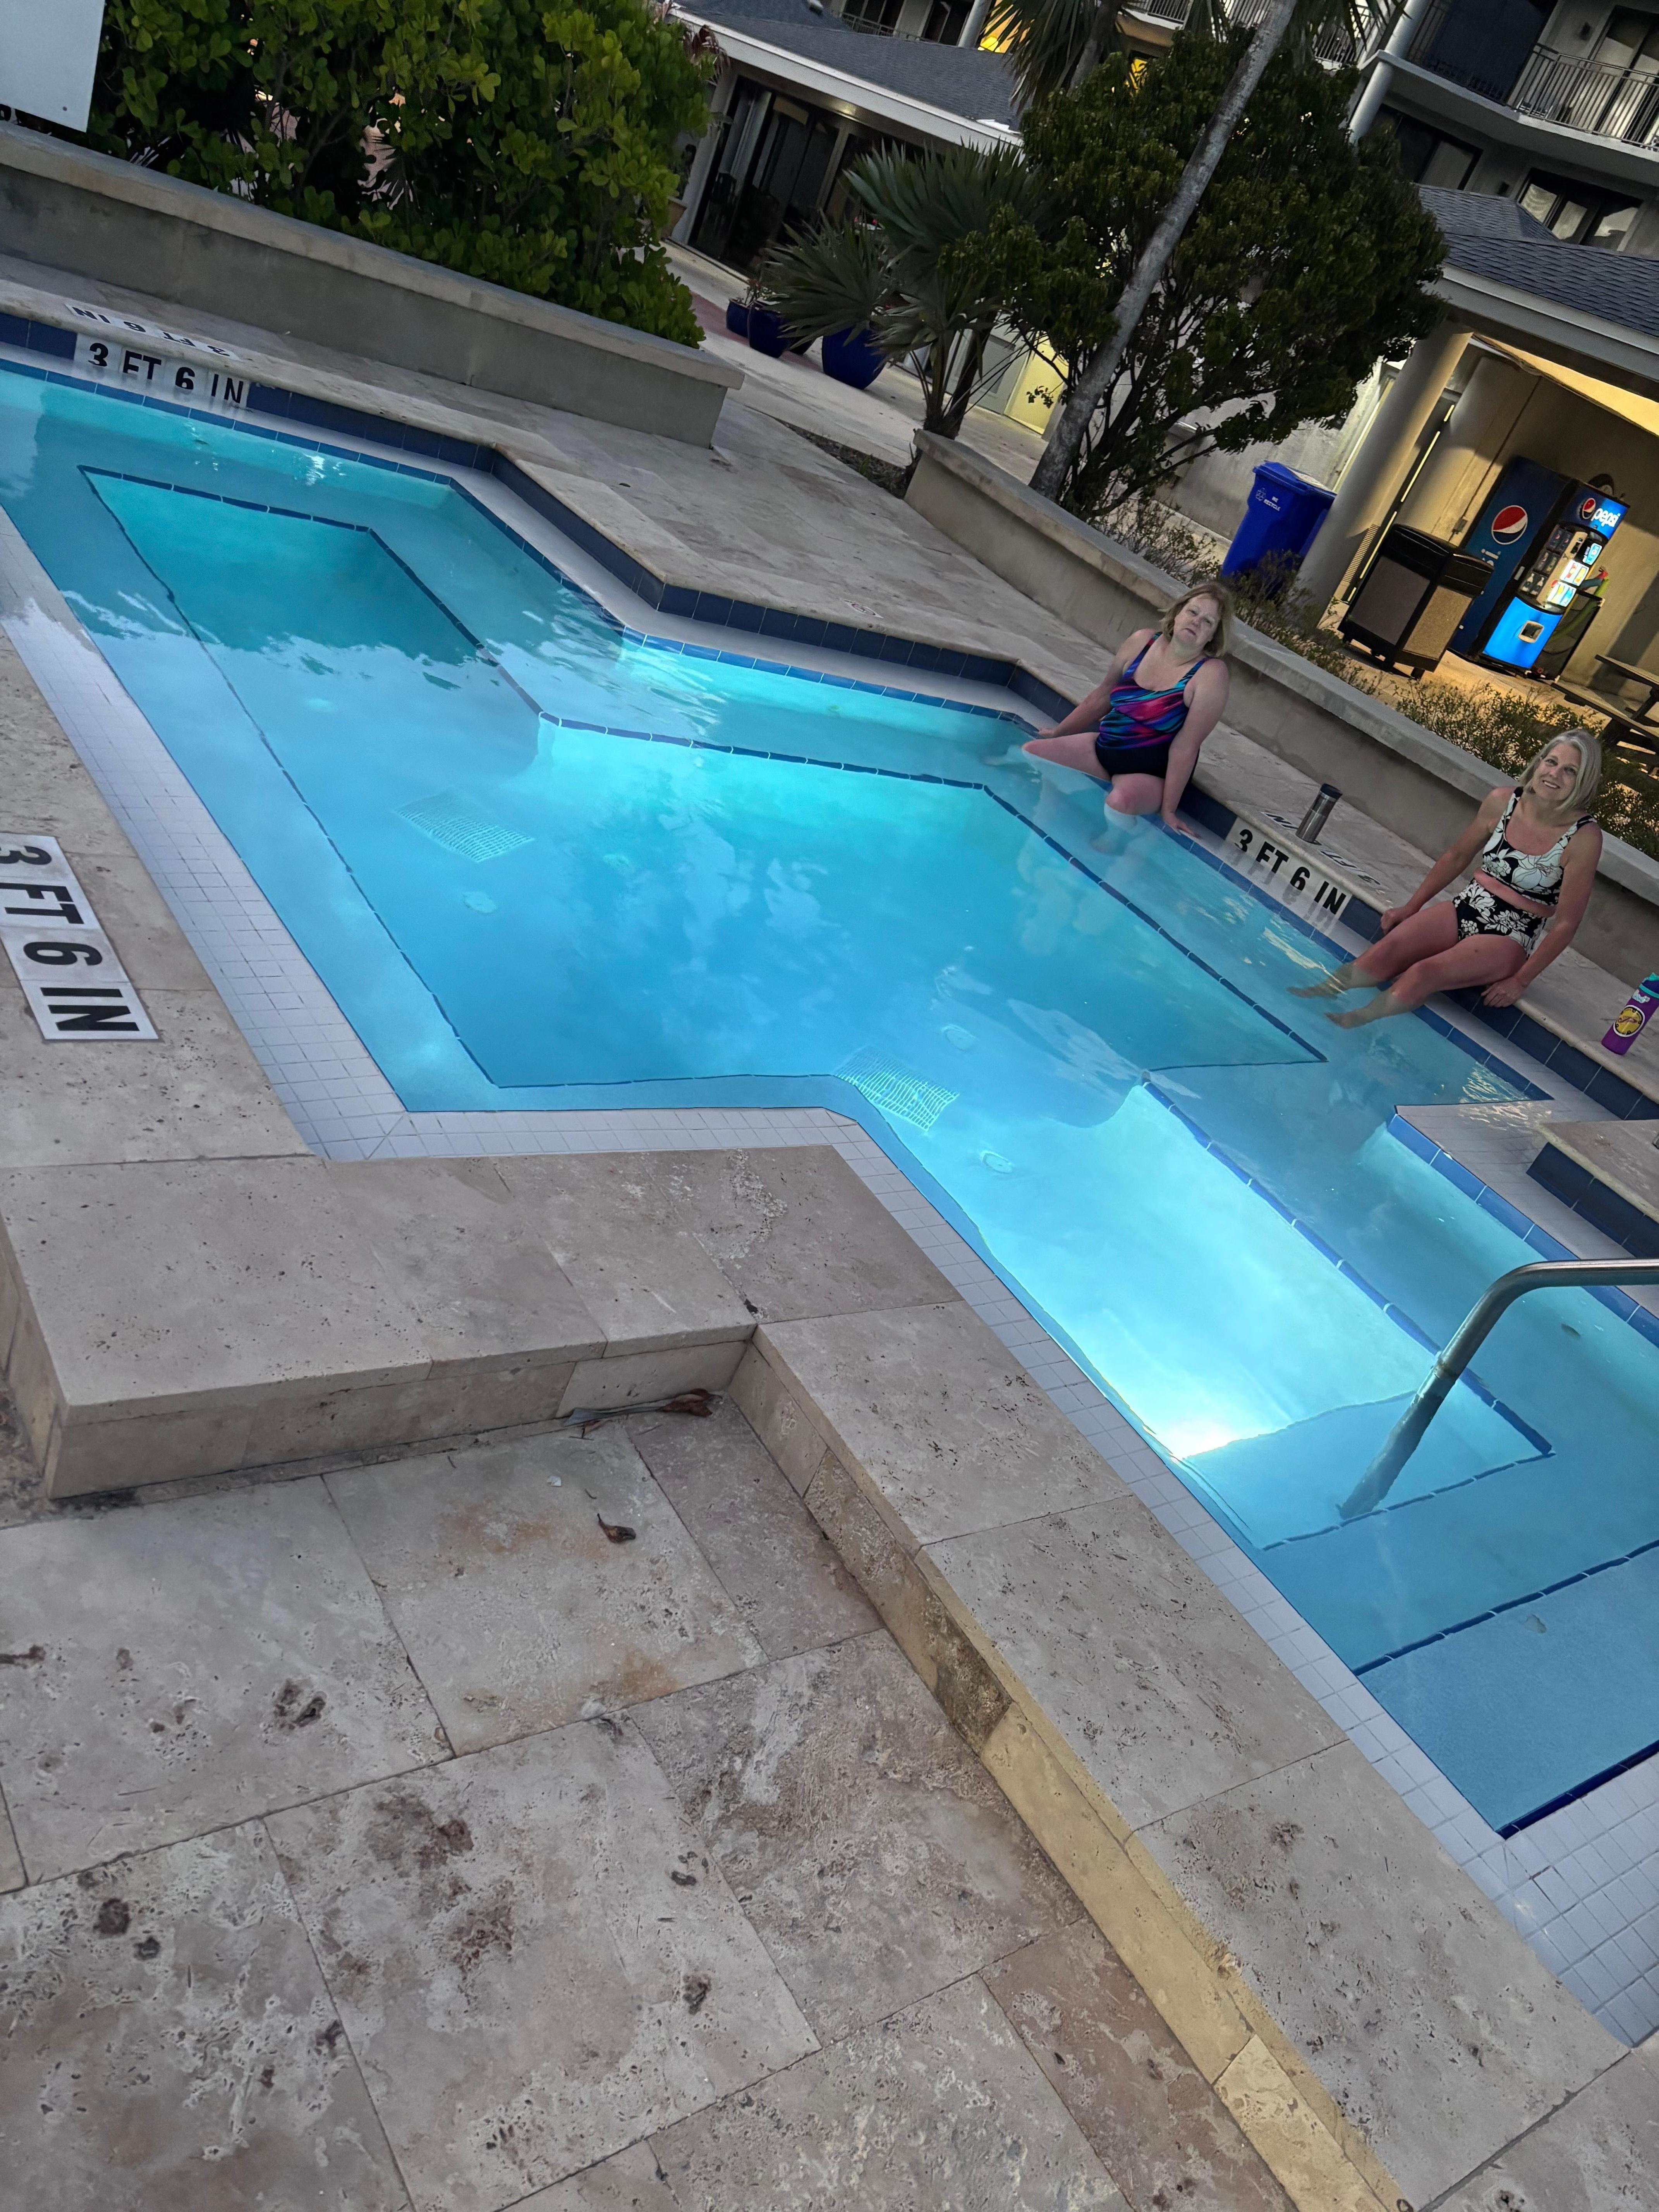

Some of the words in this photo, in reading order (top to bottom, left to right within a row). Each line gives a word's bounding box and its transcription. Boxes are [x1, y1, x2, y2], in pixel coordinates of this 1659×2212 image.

[72, 307, 111, 324] IN
[124, 321, 146, 332] 6
[162, 331, 196, 347] FT
[207, 345, 230, 356] 3
[88, 342, 109, 367] 3
[122, 350, 162, 380] FT
[175, 366, 195, 390] 6
[211, 374, 244, 404] IN
[0, 845, 52, 866] 3
[1234, 829, 1253, 852] 3
[1255, 841, 1289, 874] FT
[1290, 866, 1310, 891] 6
[1314, 881, 1346, 915] IN
[0, 882, 85, 924] FT
[23, 941, 103, 966] 6
[40, 987, 140, 1031] IN
